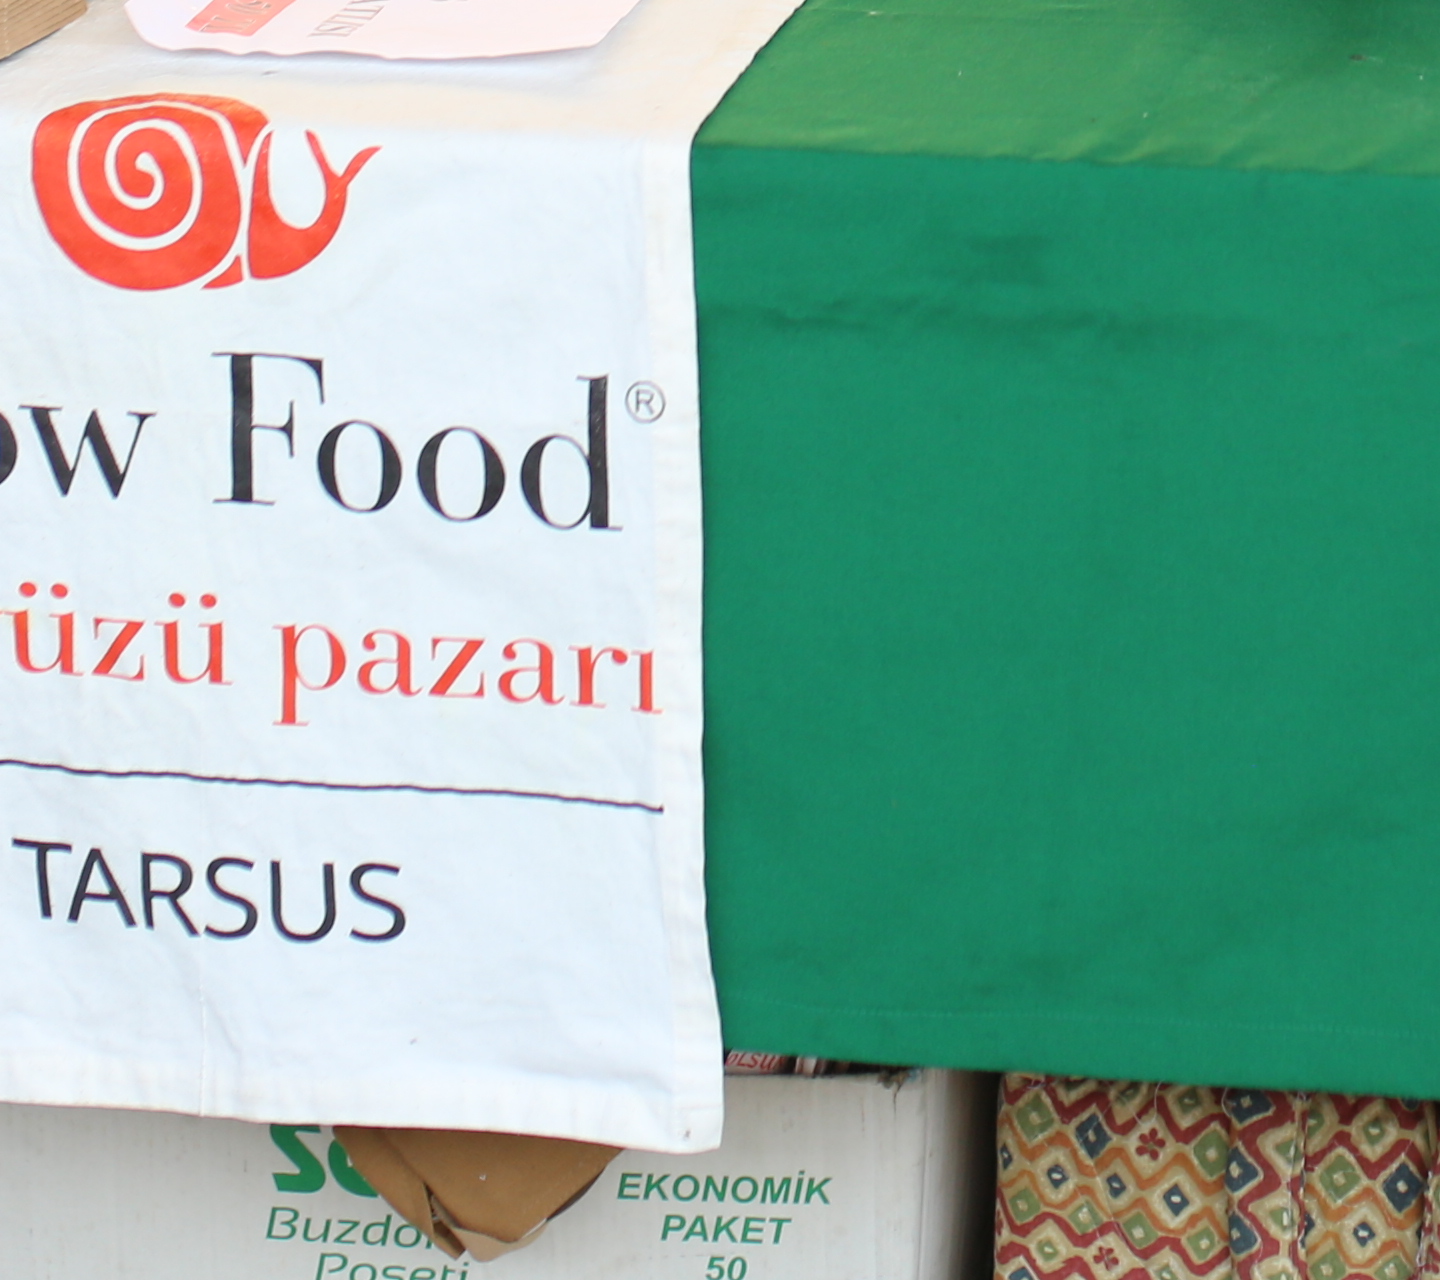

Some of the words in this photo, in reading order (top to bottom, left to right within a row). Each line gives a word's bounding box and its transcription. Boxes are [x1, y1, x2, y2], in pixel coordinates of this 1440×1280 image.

[271, 621, 664, 726] pazarı
[12, 837, 408, 943] TARSUS
[616, 1170, 832, 1205] EKONOMİK
[266, 1205, 434, 1249] Buzdo
[661, 1214, 792, 1245] PAKET
[705, 1256, 748, 1280] 50
